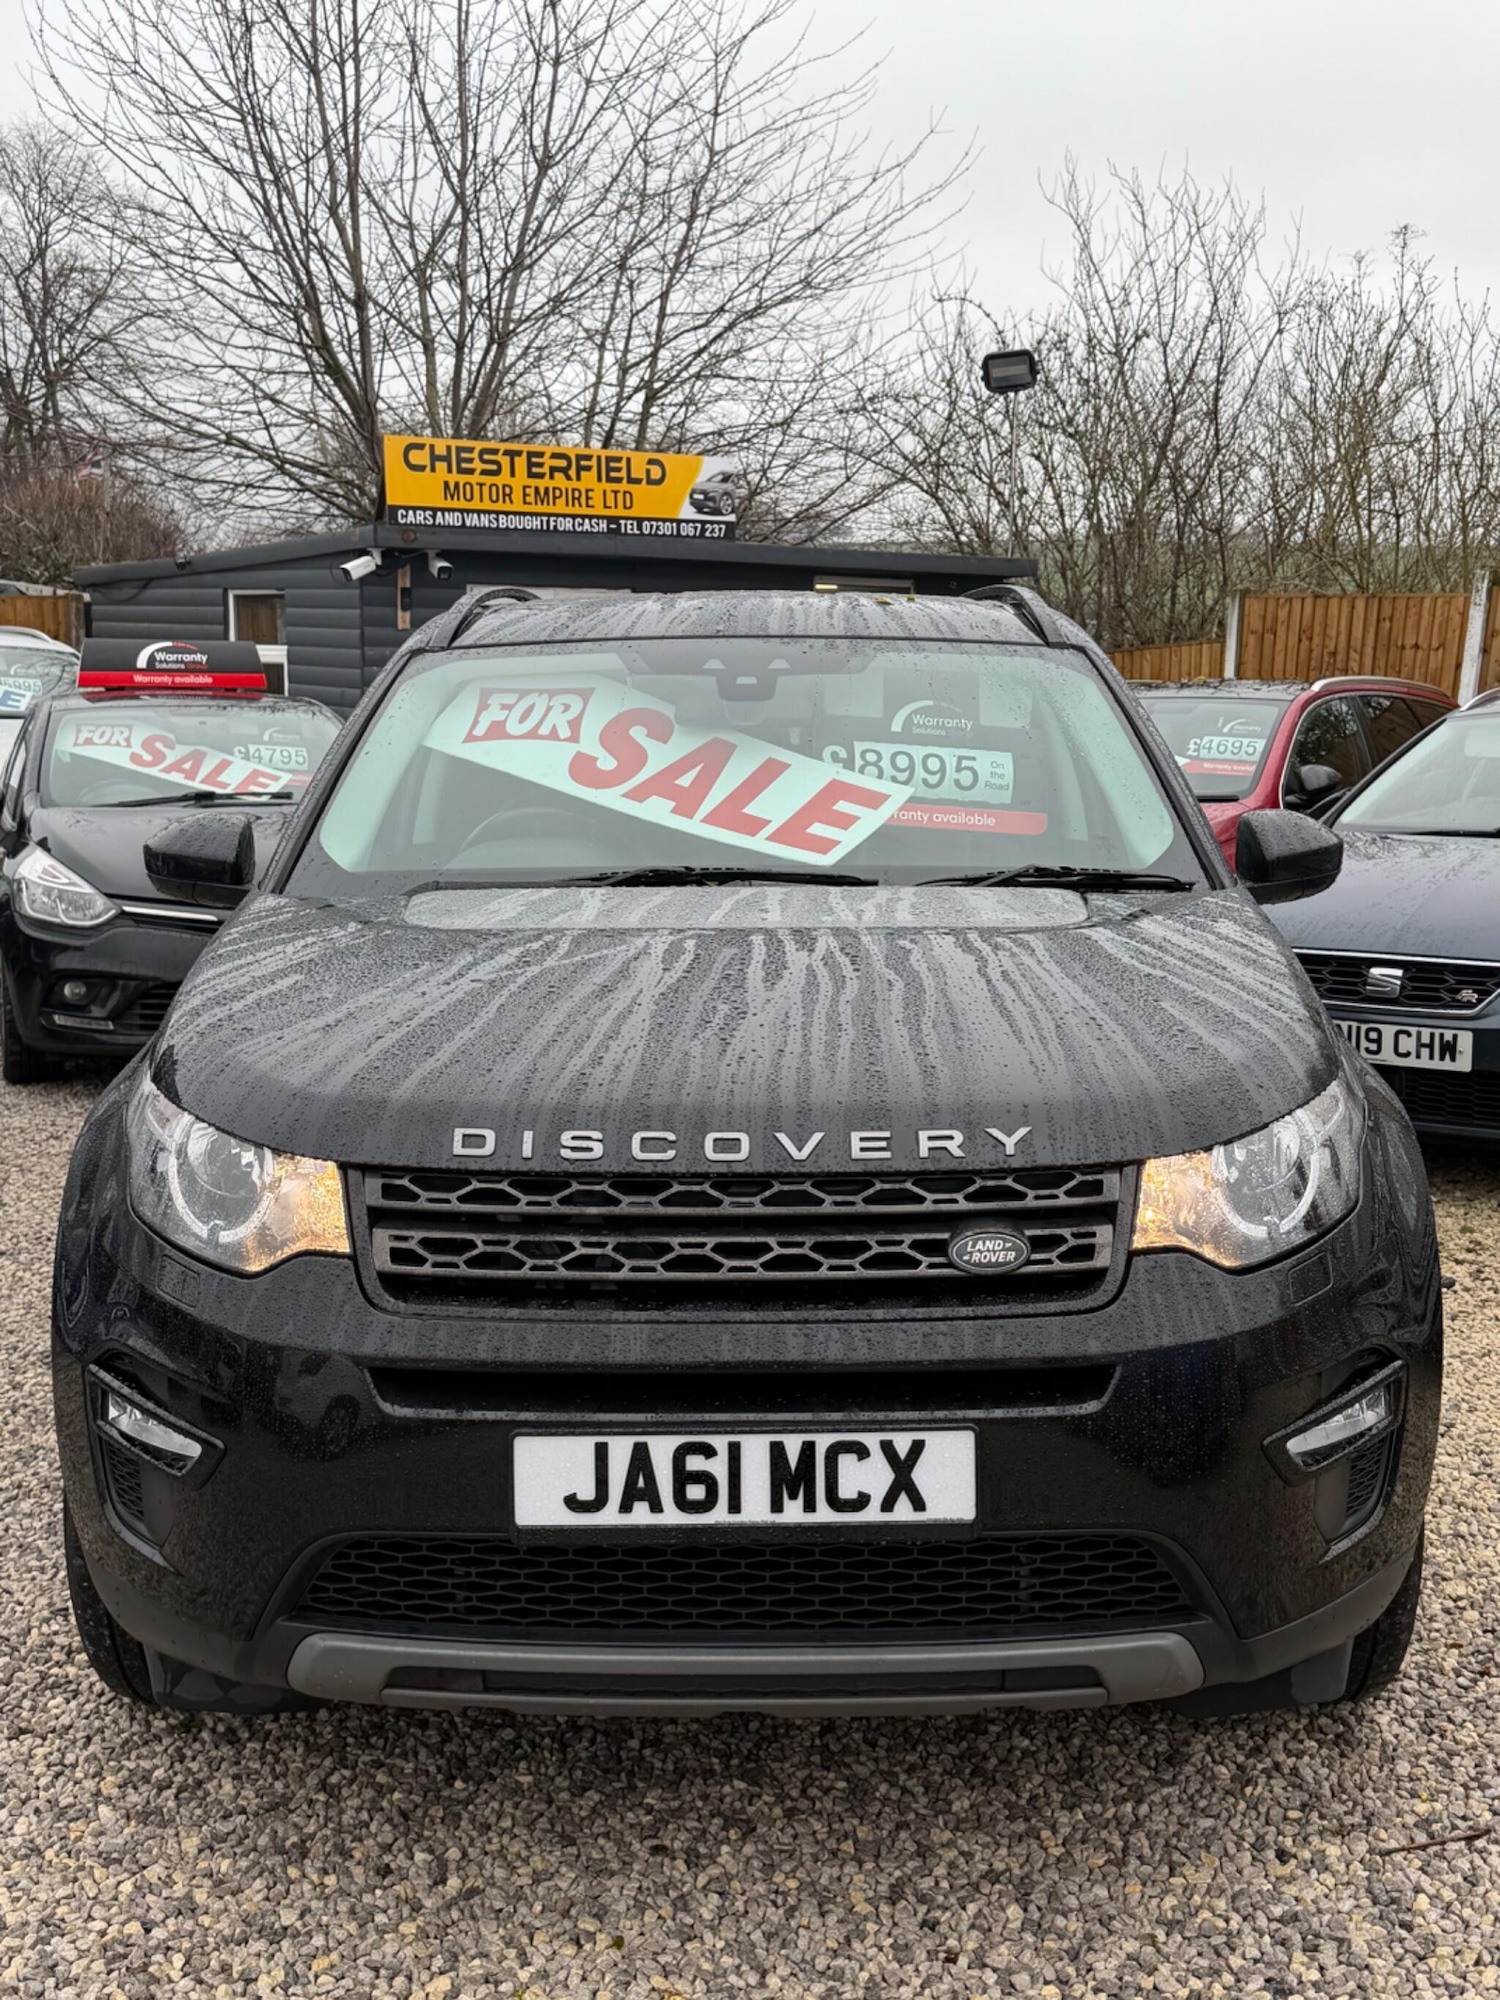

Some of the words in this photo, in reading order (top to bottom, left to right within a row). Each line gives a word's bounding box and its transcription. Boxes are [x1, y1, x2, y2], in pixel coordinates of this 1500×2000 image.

[402, 442, 667, 487] CHESTERFIELD
[442, 480, 514, 505] MOTOR
[522, 485, 596, 509] EMPIRE
[602, 489, 635, 511] LTD
[397, 508, 434, 525] CARS
[434, 511, 463, 527] AND
[463, 512, 498, 528] VANS
[499, 514, 549, 531] BOUGHT
[549, 517, 575, 532] FOR
[574, 519, 608, 533] CASH
[618, 520, 641, 535] TEL
[642, 521, 677, 536] 07301
[680, 523, 701, 537] 067
[704, 524, 727, 538] 237
[153, 651, 209, 665] Warranty
[154, 661, 186, 669] Solutions
[132, 674, 173, 685] Warranty
[173, 674, 214, 684] available
[912, 713, 974, 732] Warranty
[233, 746, 307, 766] £4795
[1186, 738, 1259, 757] £4695
[76, 723, 132, 748] FOR
[129, 734, 283, 796] SALE
[821, 745, 980, 792] £8995
[990, 760, 1005, 770] On
[471, 691, 587, 741] FOR
[567, 707, 893, 855] SALE
[989, 770, 1006, 780] the
[984, 780, 1010, 792] Road
[893, 808, 931, 825] ranty
[932, 813, 996, 827] available
[1393, 1028, 1458, 1063] CHW
[451, 1125, 1034, 1163] DISCOVERY
[966, 1239, 1004, 1252] LAND
[970, 1250, 1017, 1264] ROVER
[562, 1440, 743, 1515] JA61
[768, 1439, 927, 1515] MCX
